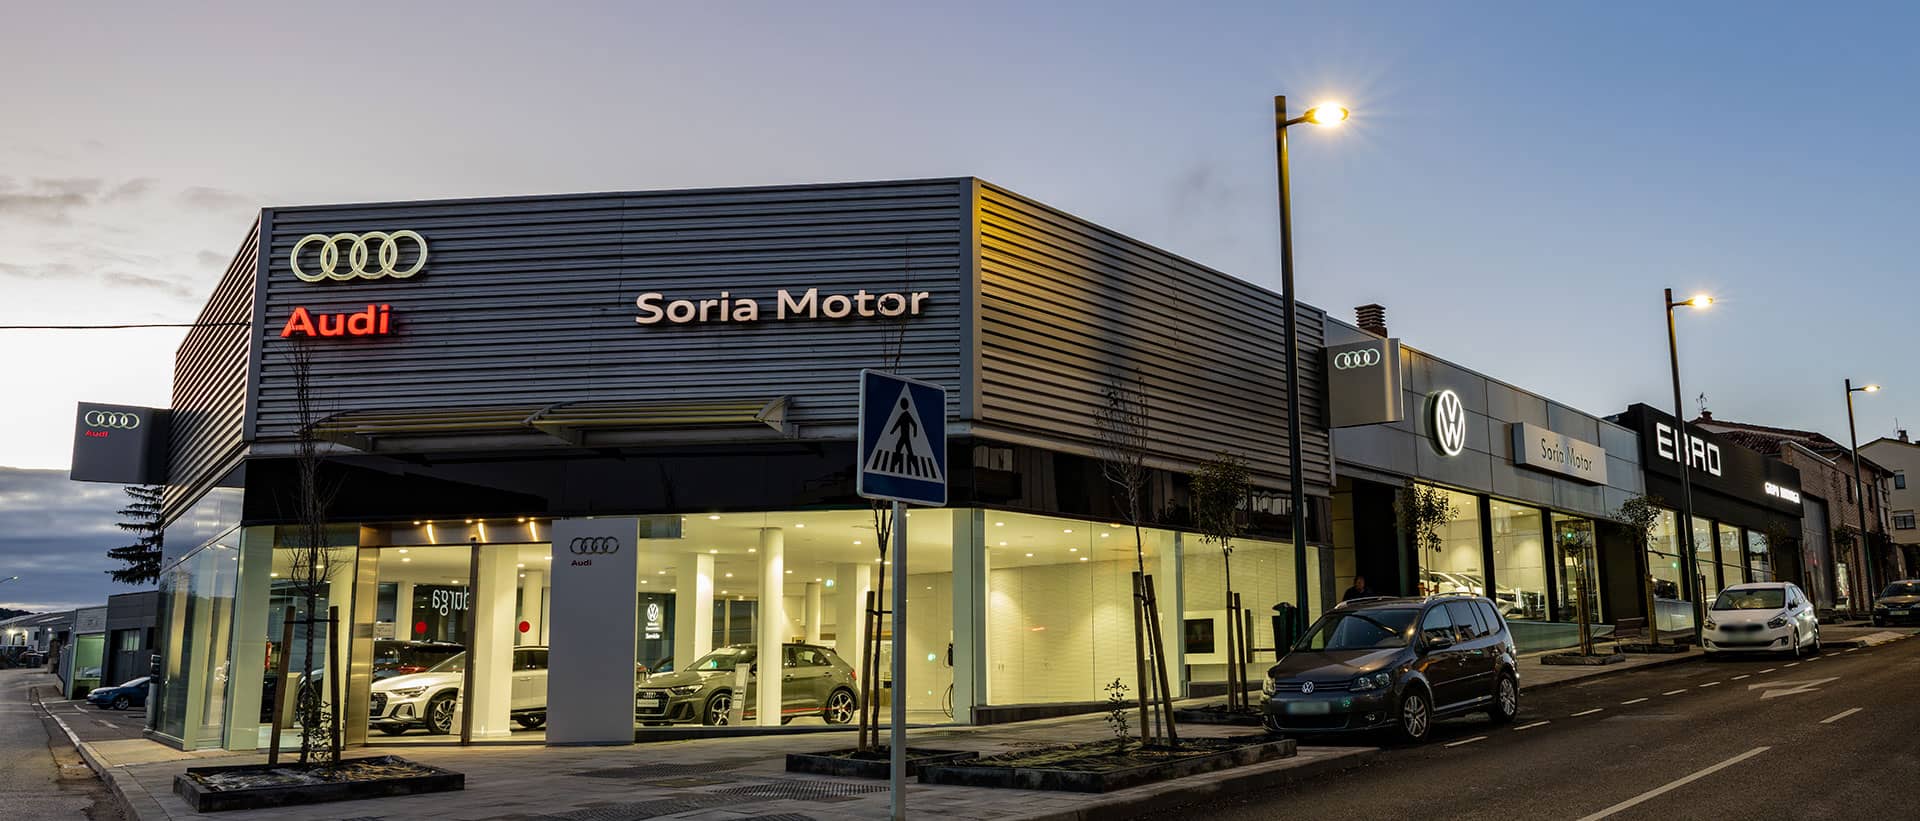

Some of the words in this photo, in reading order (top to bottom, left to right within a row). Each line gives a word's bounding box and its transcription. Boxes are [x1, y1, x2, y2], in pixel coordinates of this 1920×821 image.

[280, 303, 390, 338] Audi
[635, 291, 759, 325] Soria
[777, 288, 929, 320] Motor
[85, 430, 109, 438] Audi
[1541, 437, 1565, 464] Soria
[1565, 446, 1592, 471] Motor
[571, 559, 592, 567] Audi
